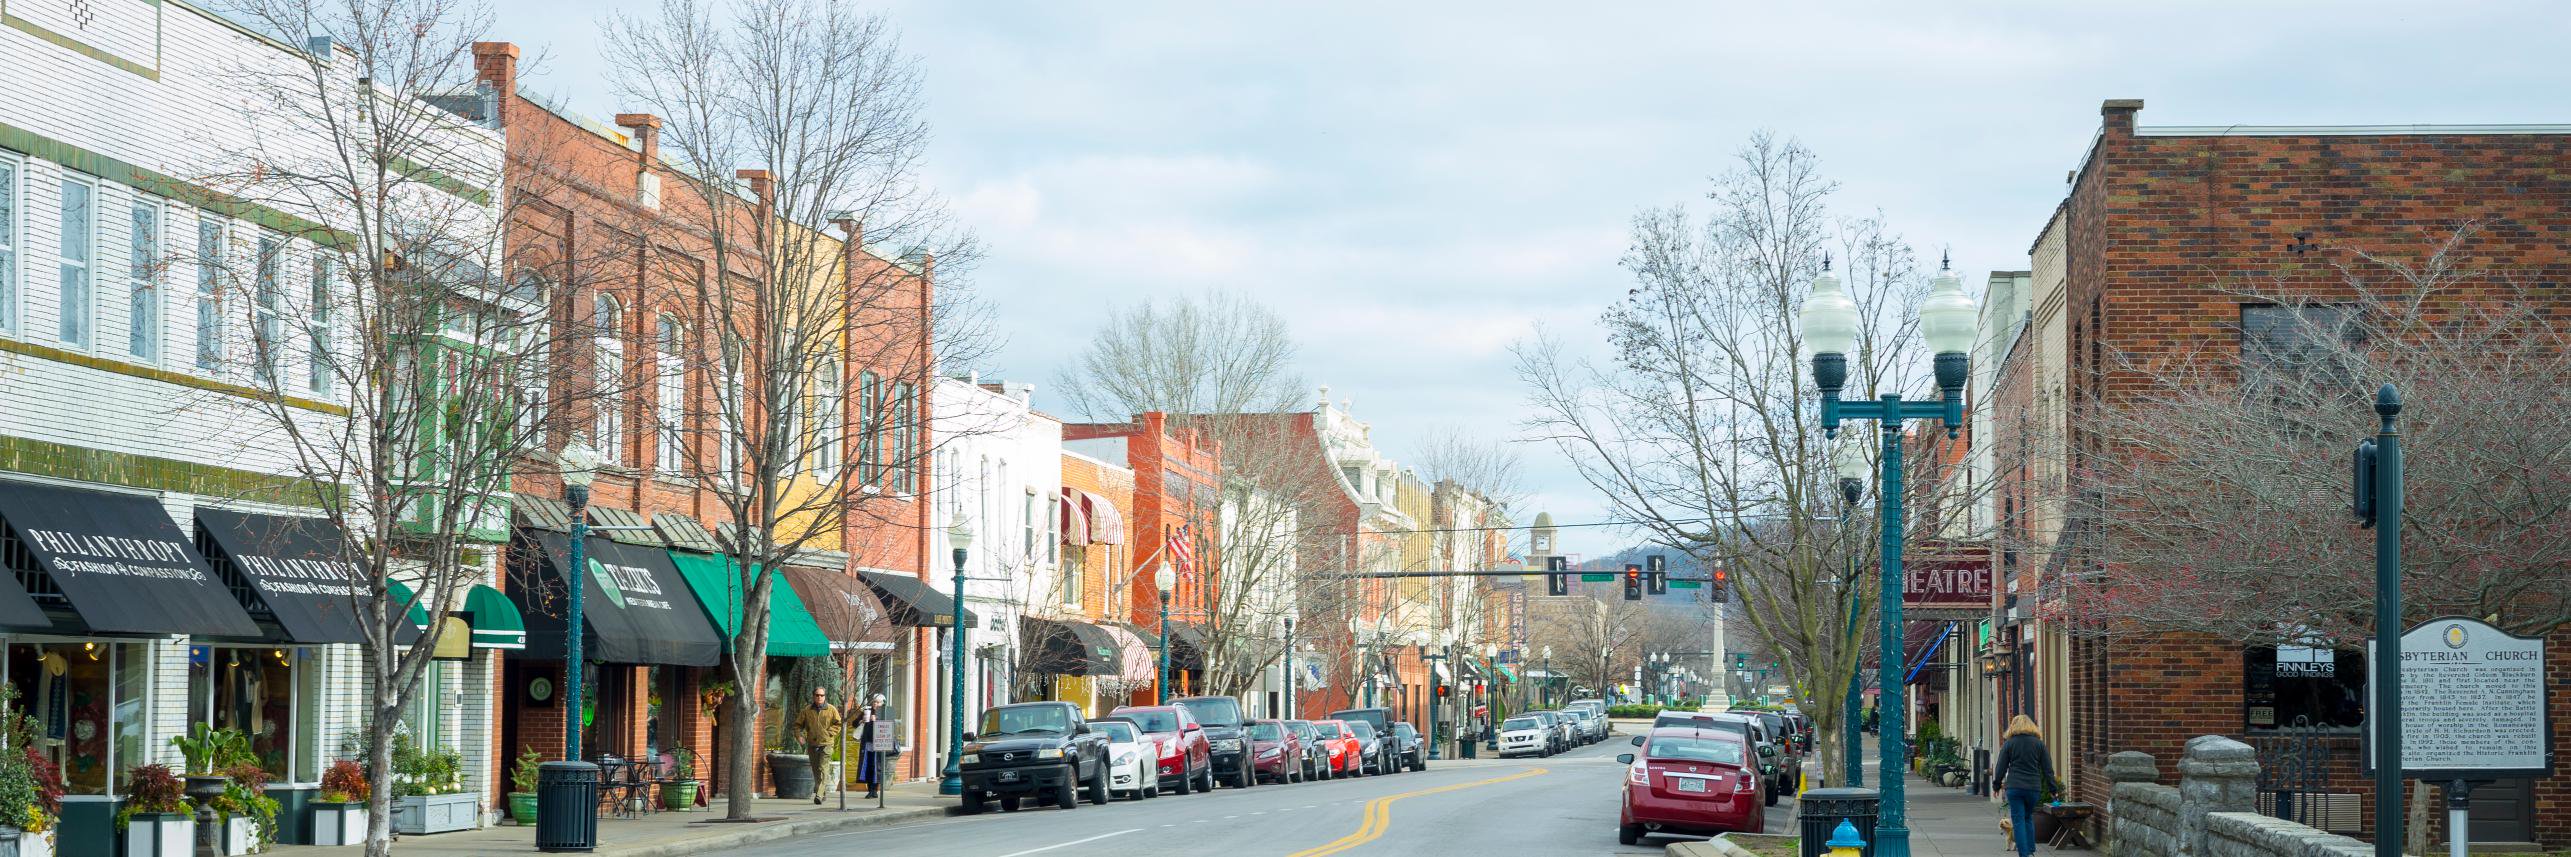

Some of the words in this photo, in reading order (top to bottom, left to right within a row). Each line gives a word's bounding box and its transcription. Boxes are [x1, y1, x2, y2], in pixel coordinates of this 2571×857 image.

[28, 528, 191, 563] PHILANTHROPY
[74, 560, 120, 576] FASHION
[128, 564, 189, 580] COMPASSION
[2400, 651, 2468, 661] SBYTERIAN
[2486, 651, 2538, 661] CHURCH
[2276, 662, 2335, 672] FINNLEYS
